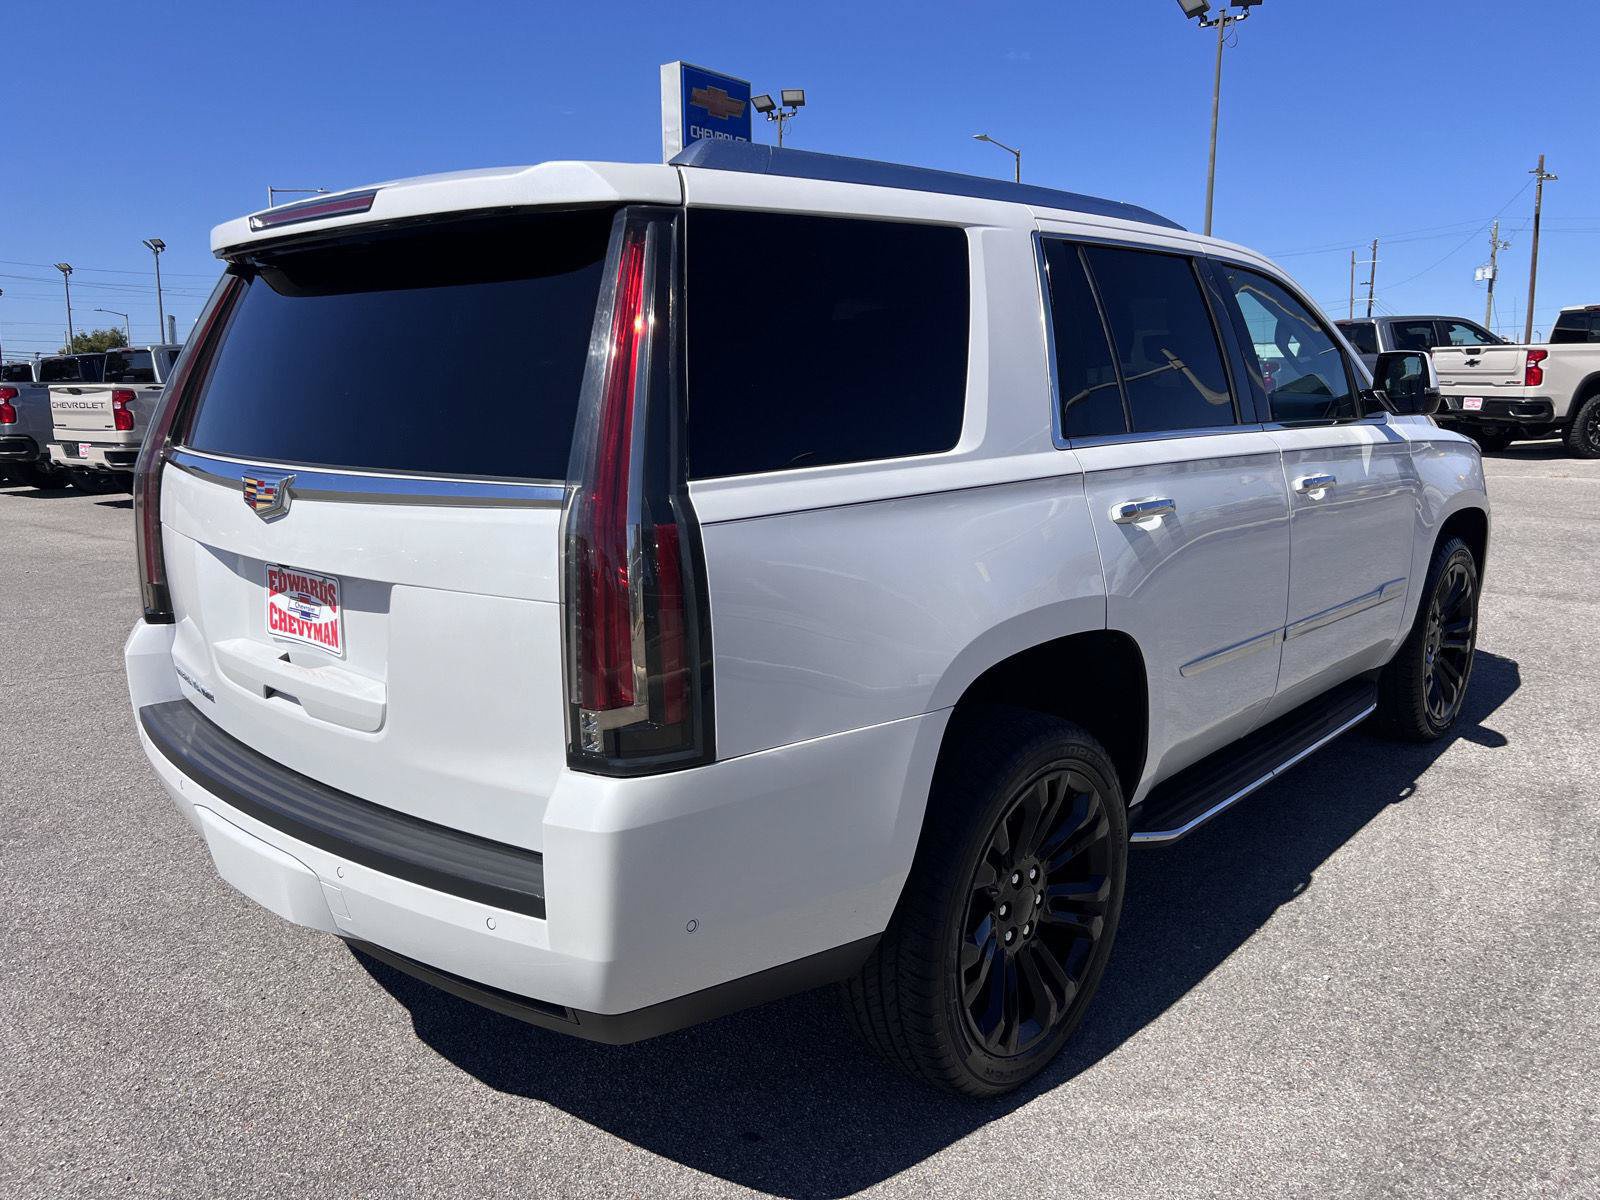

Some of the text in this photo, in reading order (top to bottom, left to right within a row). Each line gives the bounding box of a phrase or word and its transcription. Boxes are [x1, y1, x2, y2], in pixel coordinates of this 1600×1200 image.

[51, 401, 106, 409] CHEVROLET
[268, 569, 337, 613] EDWARDS
[269, 601, 339, 649] CHEVYMAN
